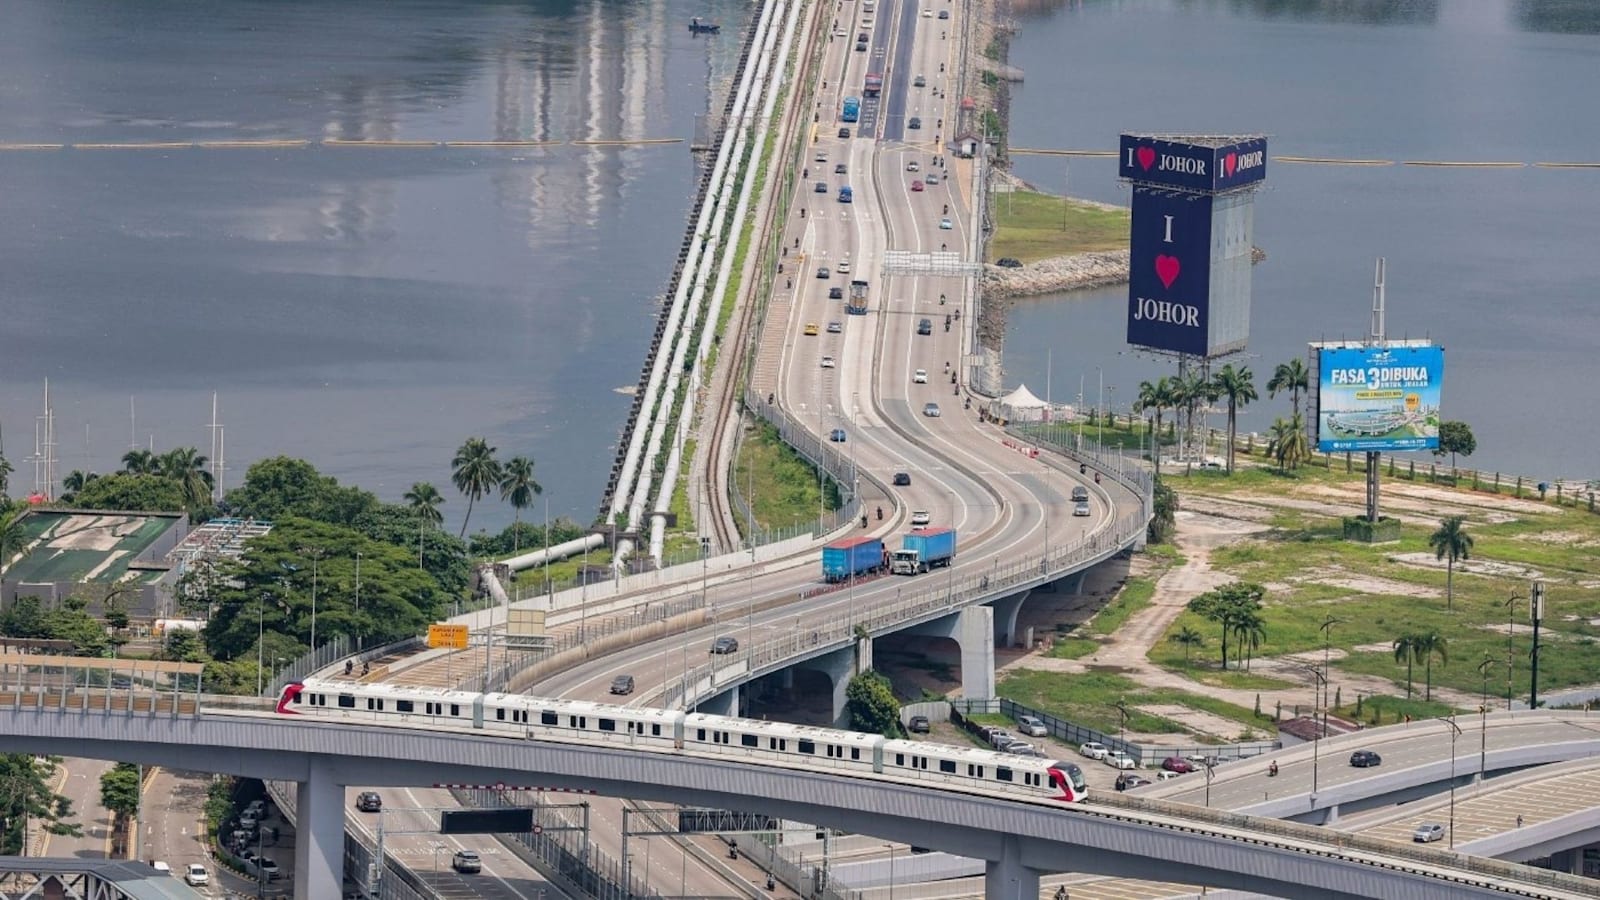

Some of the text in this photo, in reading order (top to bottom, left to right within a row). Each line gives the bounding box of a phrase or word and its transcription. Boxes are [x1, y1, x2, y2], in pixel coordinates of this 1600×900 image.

[1127, 148, 1206, 175] I JOHOR
[1220, 151, 1263, 178] I JOHOR
[1163, 215, 1174, 243] I
[1134, 297, 1200, 327] JOHOR
[1332, 367, 1428, 390] FASA 3 DIBUKA
